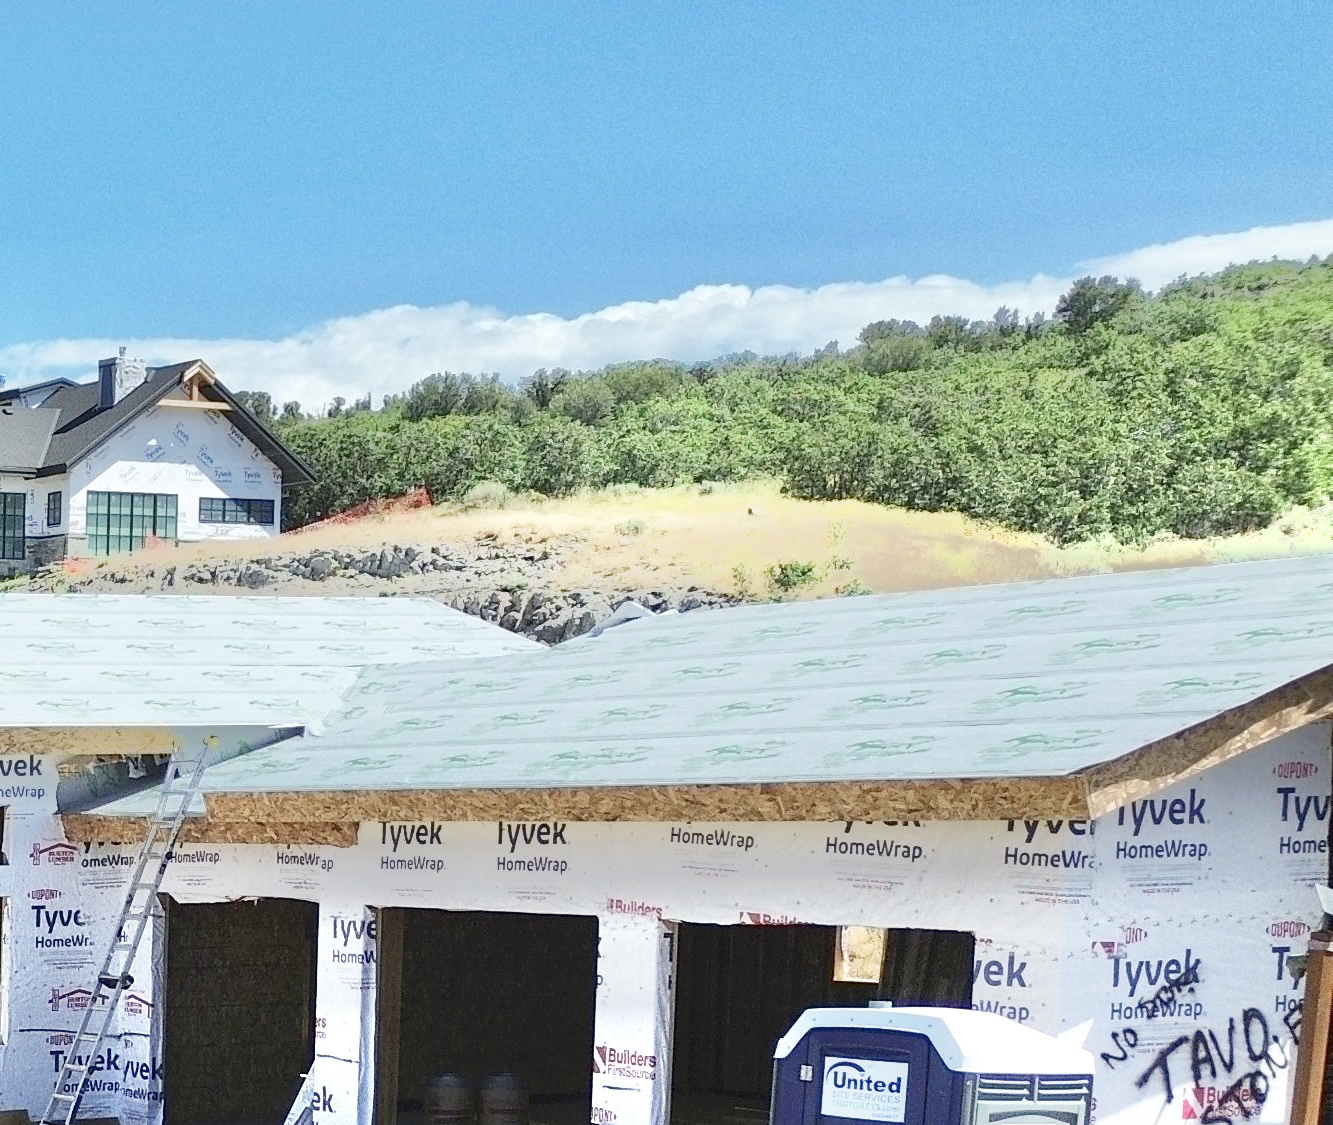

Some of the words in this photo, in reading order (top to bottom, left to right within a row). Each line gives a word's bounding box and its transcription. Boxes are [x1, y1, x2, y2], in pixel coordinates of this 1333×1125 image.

[1277, 762, 1315, 778] DUPONT
[1277, 787, 1330, 831] Tyv
[670, 826, 755, 852] HomeWrap
[826, 837, 924, 862] HomeWrap
[1279, 837, 1328, 855] Home
[1116, 840, 1208, 860] HomeWrap
[81, 854, 134, 868] omeWrap
[381, 856, 445, 874] HomeWrap
[497, 856, 569, 875] HomeWrap
[1270, 921, 1308, 938] DUPONT
[972, 951, 1028, 988] vek
[1111, 949, 1201, 998] Tyvek
[972, 1001, 1030, 1023] Wrap
[608, 1048, 657, 1069] Builders
[123, 1056, 164, 1083] yvek
[833, 1070, 902, 1094] United
[853, 1092, 901, 1104] SERVICES
